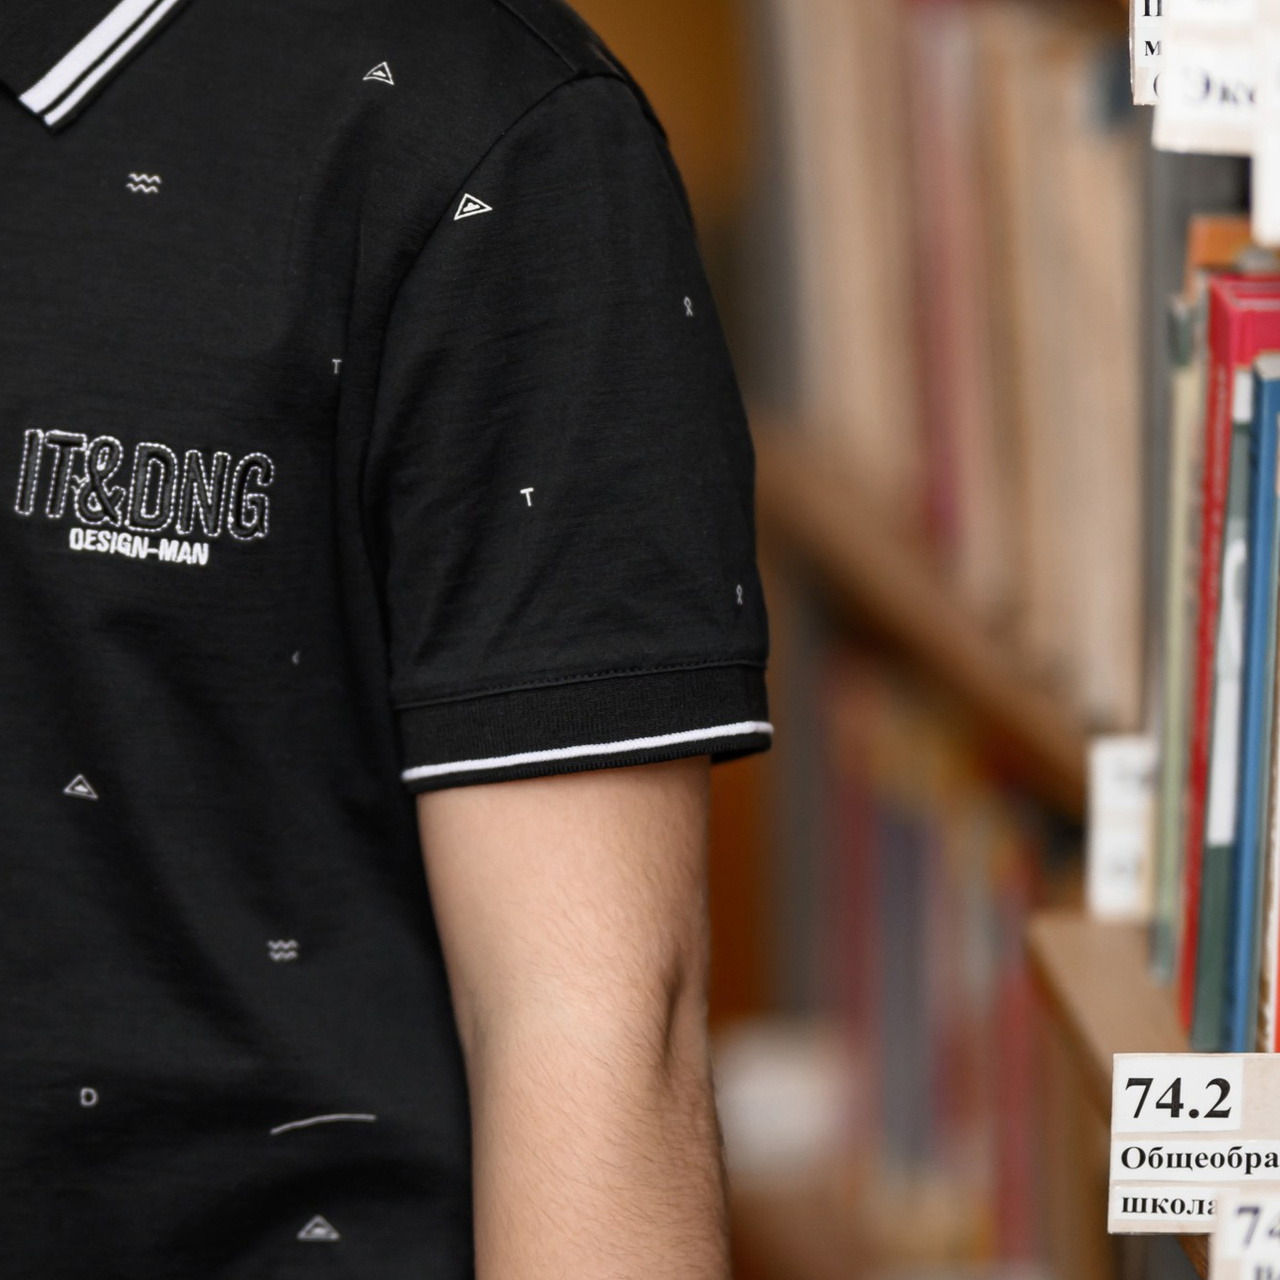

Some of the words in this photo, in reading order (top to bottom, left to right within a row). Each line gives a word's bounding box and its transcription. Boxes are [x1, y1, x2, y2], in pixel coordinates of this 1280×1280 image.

[15, 428, 275, 540] IT&DNG
[69, 526, 210, 566] DESIGN-MAN
[1125, 1077, 1232, 1119] 74.2
[1121, 1146, 1279, 1175] Общеобра
